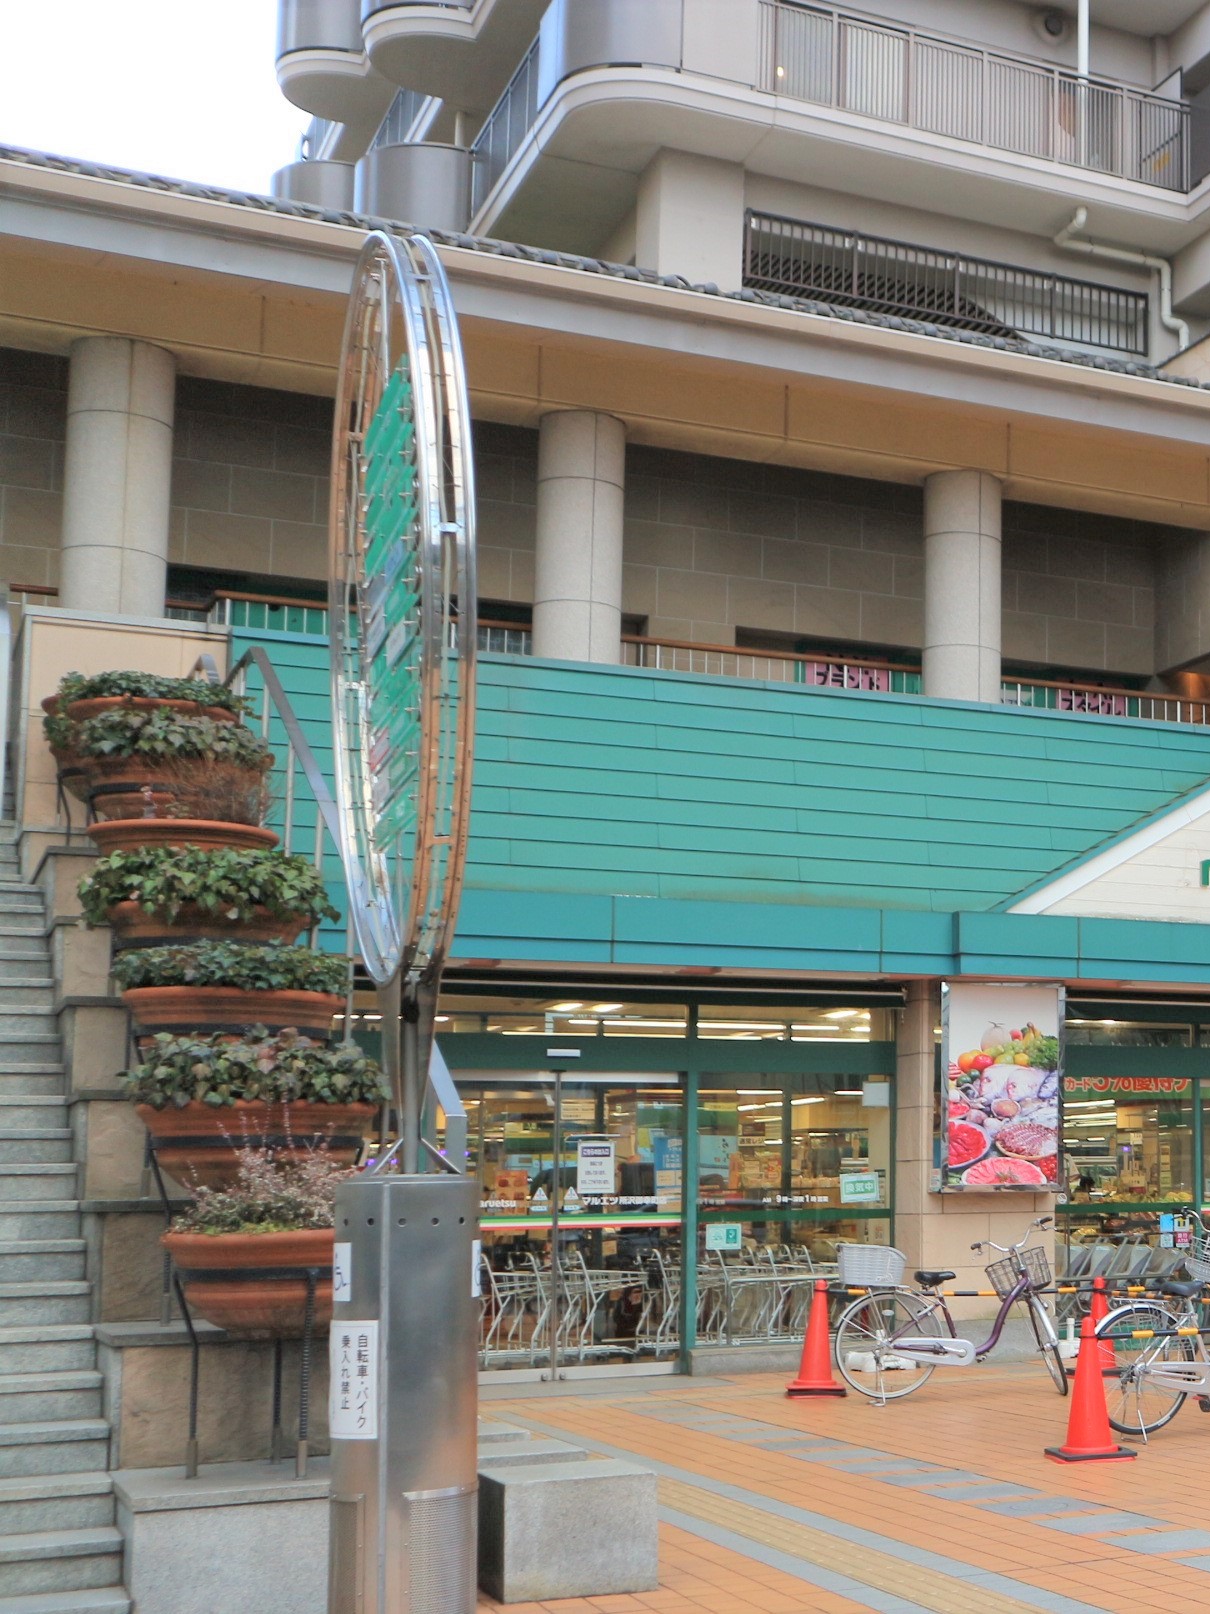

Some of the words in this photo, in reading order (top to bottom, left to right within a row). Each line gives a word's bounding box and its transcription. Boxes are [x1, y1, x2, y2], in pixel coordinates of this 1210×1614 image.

[340, 1335, 351, 1410] 乗入れ禁止
[356, 1334, 370, 1429] 自転車・バイク
